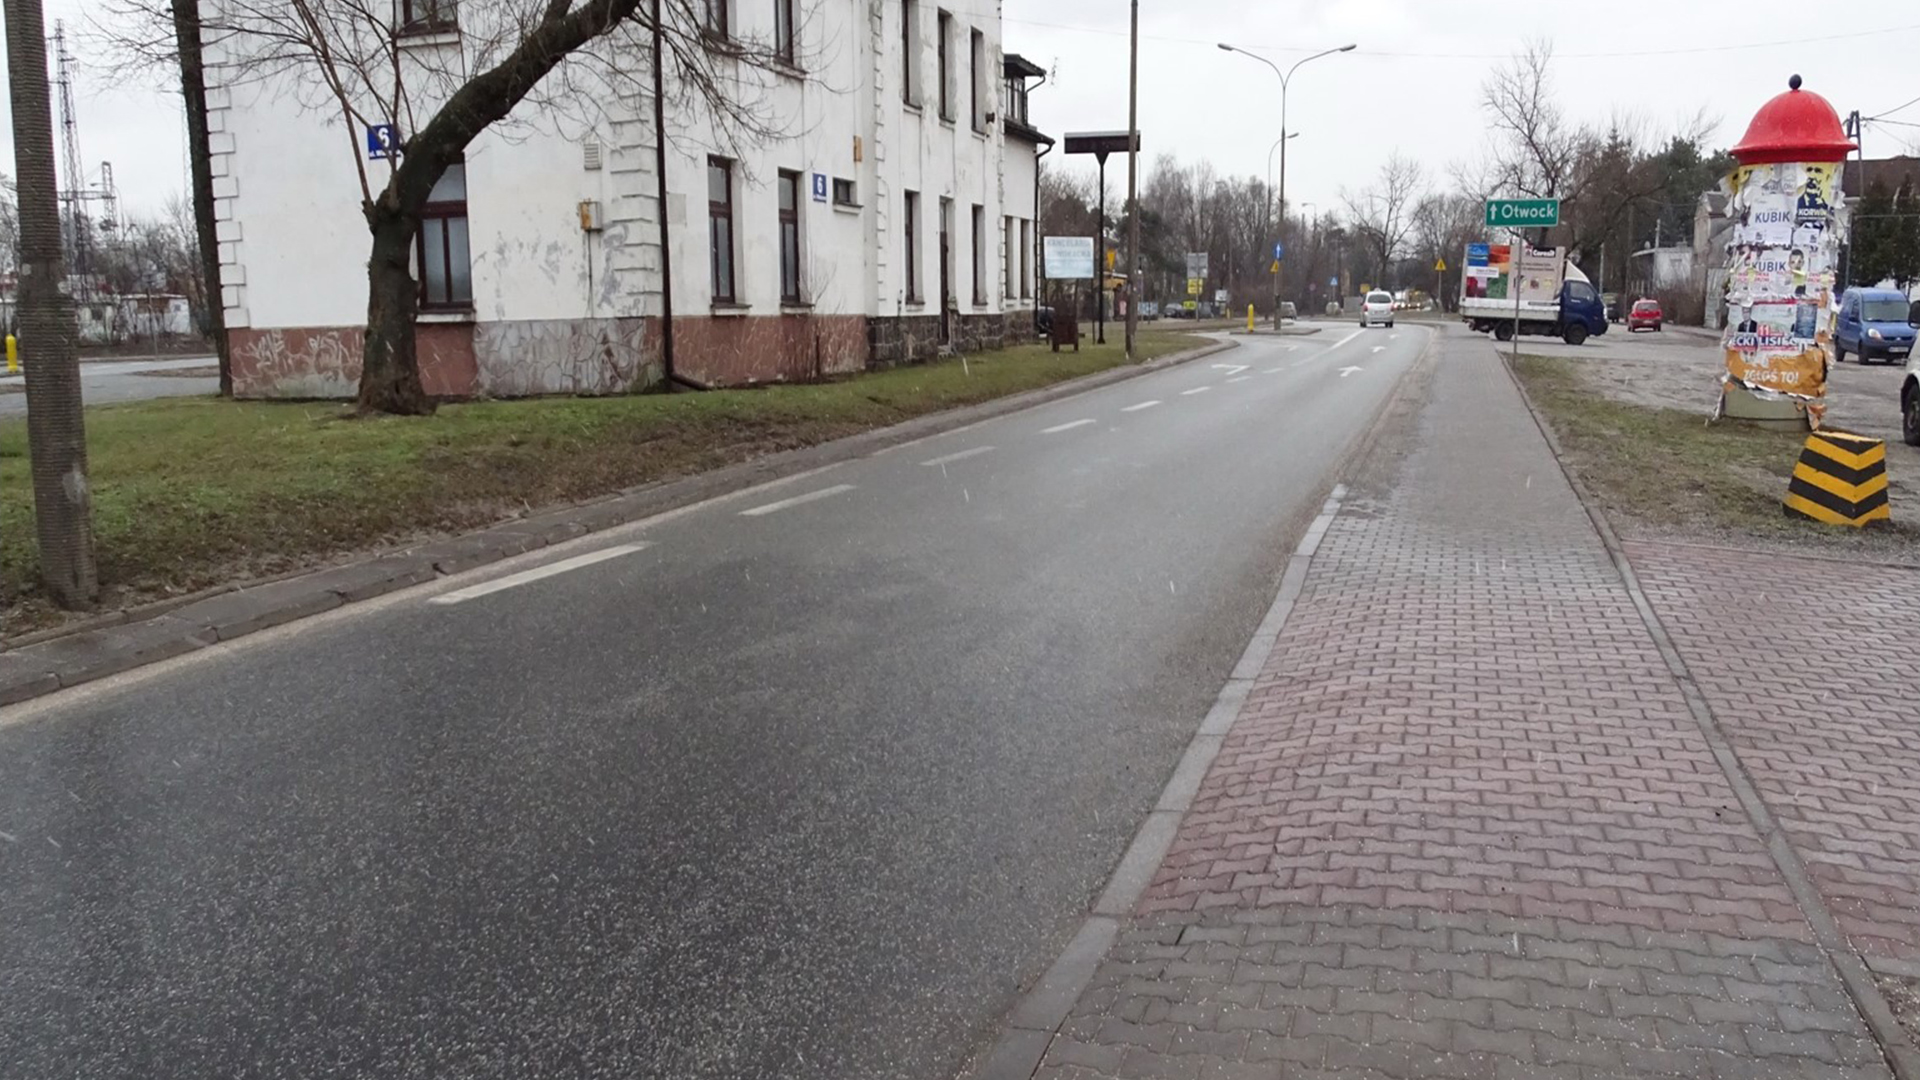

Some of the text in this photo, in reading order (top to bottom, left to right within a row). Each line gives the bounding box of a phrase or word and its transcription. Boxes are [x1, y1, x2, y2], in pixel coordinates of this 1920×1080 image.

[378, 127, 390, 148] 6
[817, 176, 823, 193] 6
[1501, 203, 1555, 218] Otwock
[1755, 211, 1790, 223] KUBIK
[1780, 370, 1799, 384] TO!
